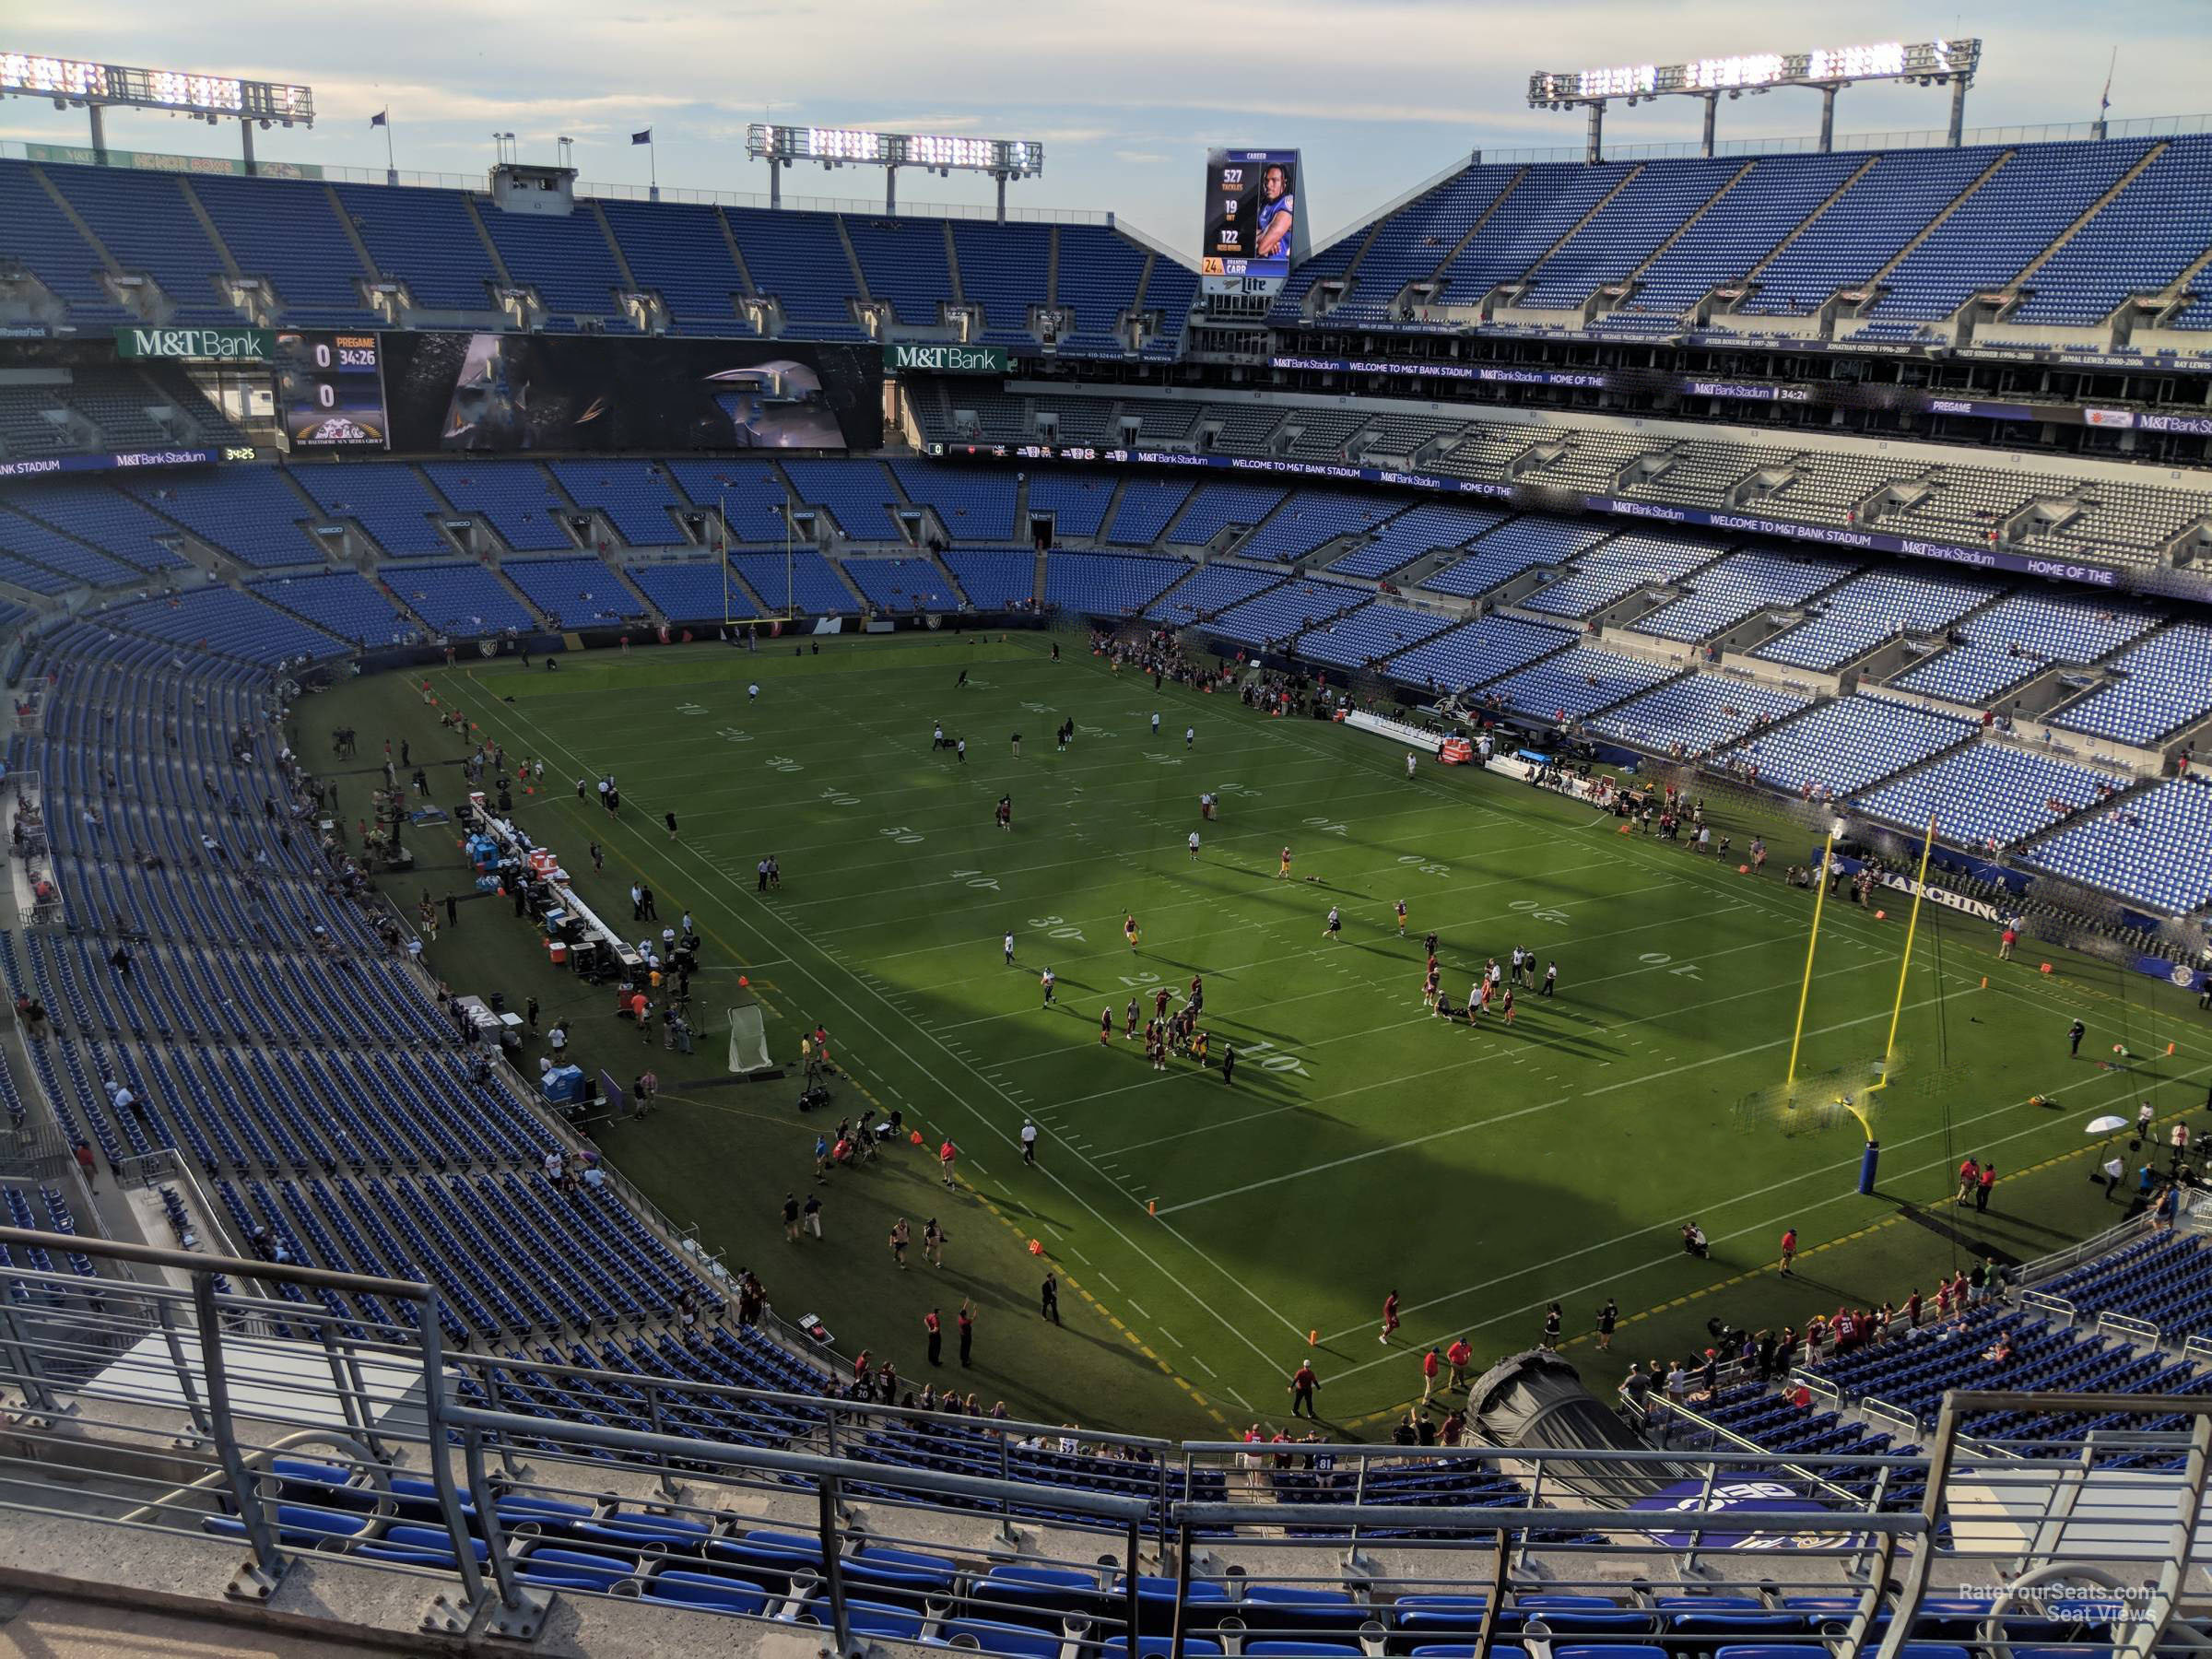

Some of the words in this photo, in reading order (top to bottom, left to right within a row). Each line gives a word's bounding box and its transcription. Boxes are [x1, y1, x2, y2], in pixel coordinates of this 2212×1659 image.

[134, 154, 189, 171] HONOR
[192, 159, 233, 173] ROWS
[1224, 170, 1242, 182] 527
[1226, 200, 1237, 214] 19
[1221, 230, 1239, 243] 122
[1206, 260, 1217, 273] 24
[1227, 265, 1246, 274] CARR
[1241, 276, 1265, 294] Lite
[133, 329, 200, 356] M&T
[205, 331, 263, 358] Bank
[336, 337, 375, 348] PREGAME
[1751, 339, 1779, 347] 1997-2005
[1827, 343, 1856, 351] JONATHAN
[1878, 346, 1910, 354] 1996-2007
[316, 345, 330, 367] 0
[340, 350, 375, 365] 34:26
[896, 347, 947, 369] M&T
[948, 348, 995, 370] Bank
[1999, 351, 2034, 359] 1996-2008
[2059, 355, 2081, 363] JAMAL
[2084, 356, 2104, 365] LEWIS
[2105, 358, 2144, 367] 2000-2006
[1274, 358, 1292, 368] M&T
[1292, 359, 1310, 369] Bank
[1310, 359, 1339, 370] Stadium
[1349, 362, 1387, 372] WELCOME
[1419, 366, 1440, 375] BANK
[1441, 367, 1472, 377] STADIUM
[2189, 361, 2212, 370] LEWIS
[1480, 370, 1498, 380] M&T
[1498, 371, 1514, 381] Bank
[1514, 371, 1542, 382] Stadium
[1550, 375, 1573, 384] HOME
[1575, 376, 1586, 384] OF
[1588, 377, 1604, 385] THE
[321, 384, 335, 406] 0
[1695, 383, 1715, 394] M&T
[1715, 384, 1735, 396] Bank
[1735, 385, 1770, 398] Stadium
[1933, 401, 1971, 413] PREGAME
[2140, 414, 2171, 429] M&T
[2171, 417, 2199, 432] Bank
[117, 454, 142, 467] M&T
[142, 453, 166, 465] Bank
[166, 451, 206, 464] Stadium
[227, 448, 255, 460] 34:25
[1138, 452, 1158, 462] M&T
[1159, 453, 1177, 464] Bank
[1177, 454, 1208, 465] Stadium
[17, 459, 60, 474] STADIUM
[1232, 459, 1272, 469] WELCOME
[1274, 462, 1285, 470] TO
[1287, 463, 1304, 472] M&T
[1306, 465, 1326, 474] BANK
[1327, 466, 1360, 477] STADIUM
[1381, 471, 1396, 482] M&T
[1397, 473, 1414, 484] Bank
[1413, 476, 1440, 488] Stadium
[1460, 482, 1482, 492] HOME
[1484, 485, 1495, 494] OF
[1612, 500, 1632, 513] M&T
[1632, 503, 1653, 515] Bank
[1653, 506, 1685, 520] Stadium
[1711, 514, 1758, 529] WELCOME
[1759, 521, 1773, 532] TO
[1775, 523, 1796, 535] M&T
[1797, 526, 1825, 539] BANK
[1827, 531, 1872, 546] STADIUM
[1901, 540, 1928, 555] M&T
[1927, 544, 1953, 559] Bank
[1953, 548, 1994, 566] Stadium
[2028, 559, 2064, 575] HOME
[2066, 566, 2084, 579] OF
[2088, 568, 2112, 583] THE
[764, 754, 806, 771] 30
[819, 787, 861, 805] 40
[878, 827, 924, 843] 50
[1028, 915, 1082, 937] 30
[1639, 952, 1702, 975] 10
[1118, 971, 1182, 998] 20
[1236, 1041, 1301, 1071] 10
[1841, 1321, 1854, 1334] 21
[857, 1389, 868, 1399] 20
[1315, 1459, 1326, 1469] 81
